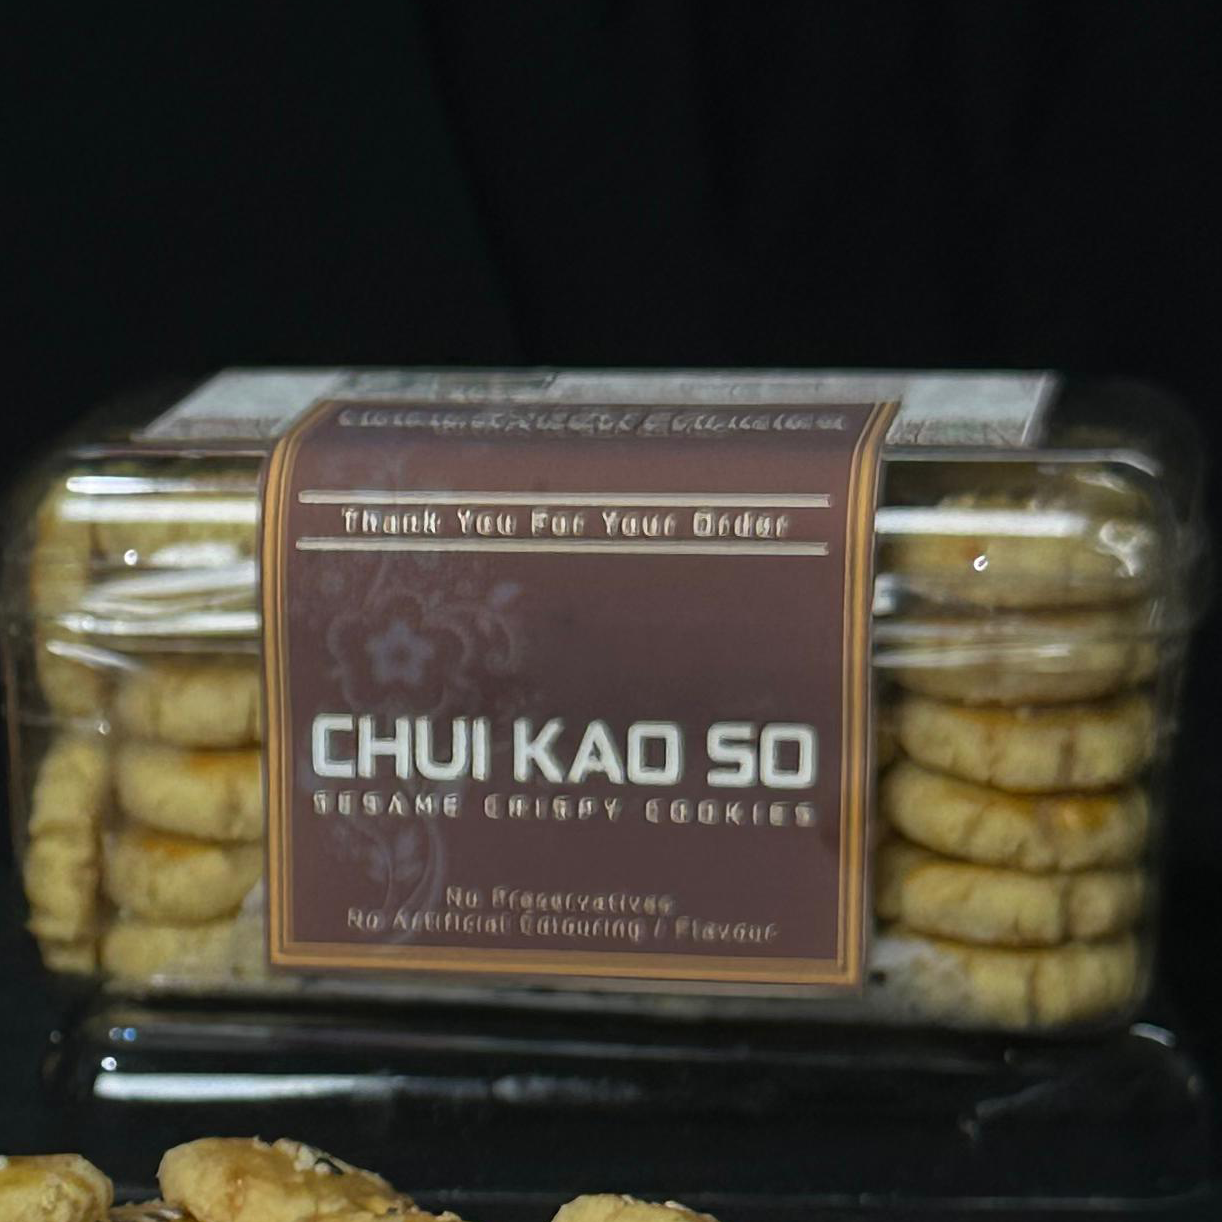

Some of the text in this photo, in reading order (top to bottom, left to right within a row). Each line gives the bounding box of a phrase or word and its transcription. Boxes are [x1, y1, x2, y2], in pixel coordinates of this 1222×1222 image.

[312, 714, 819, 789] CHUI KAO SO
